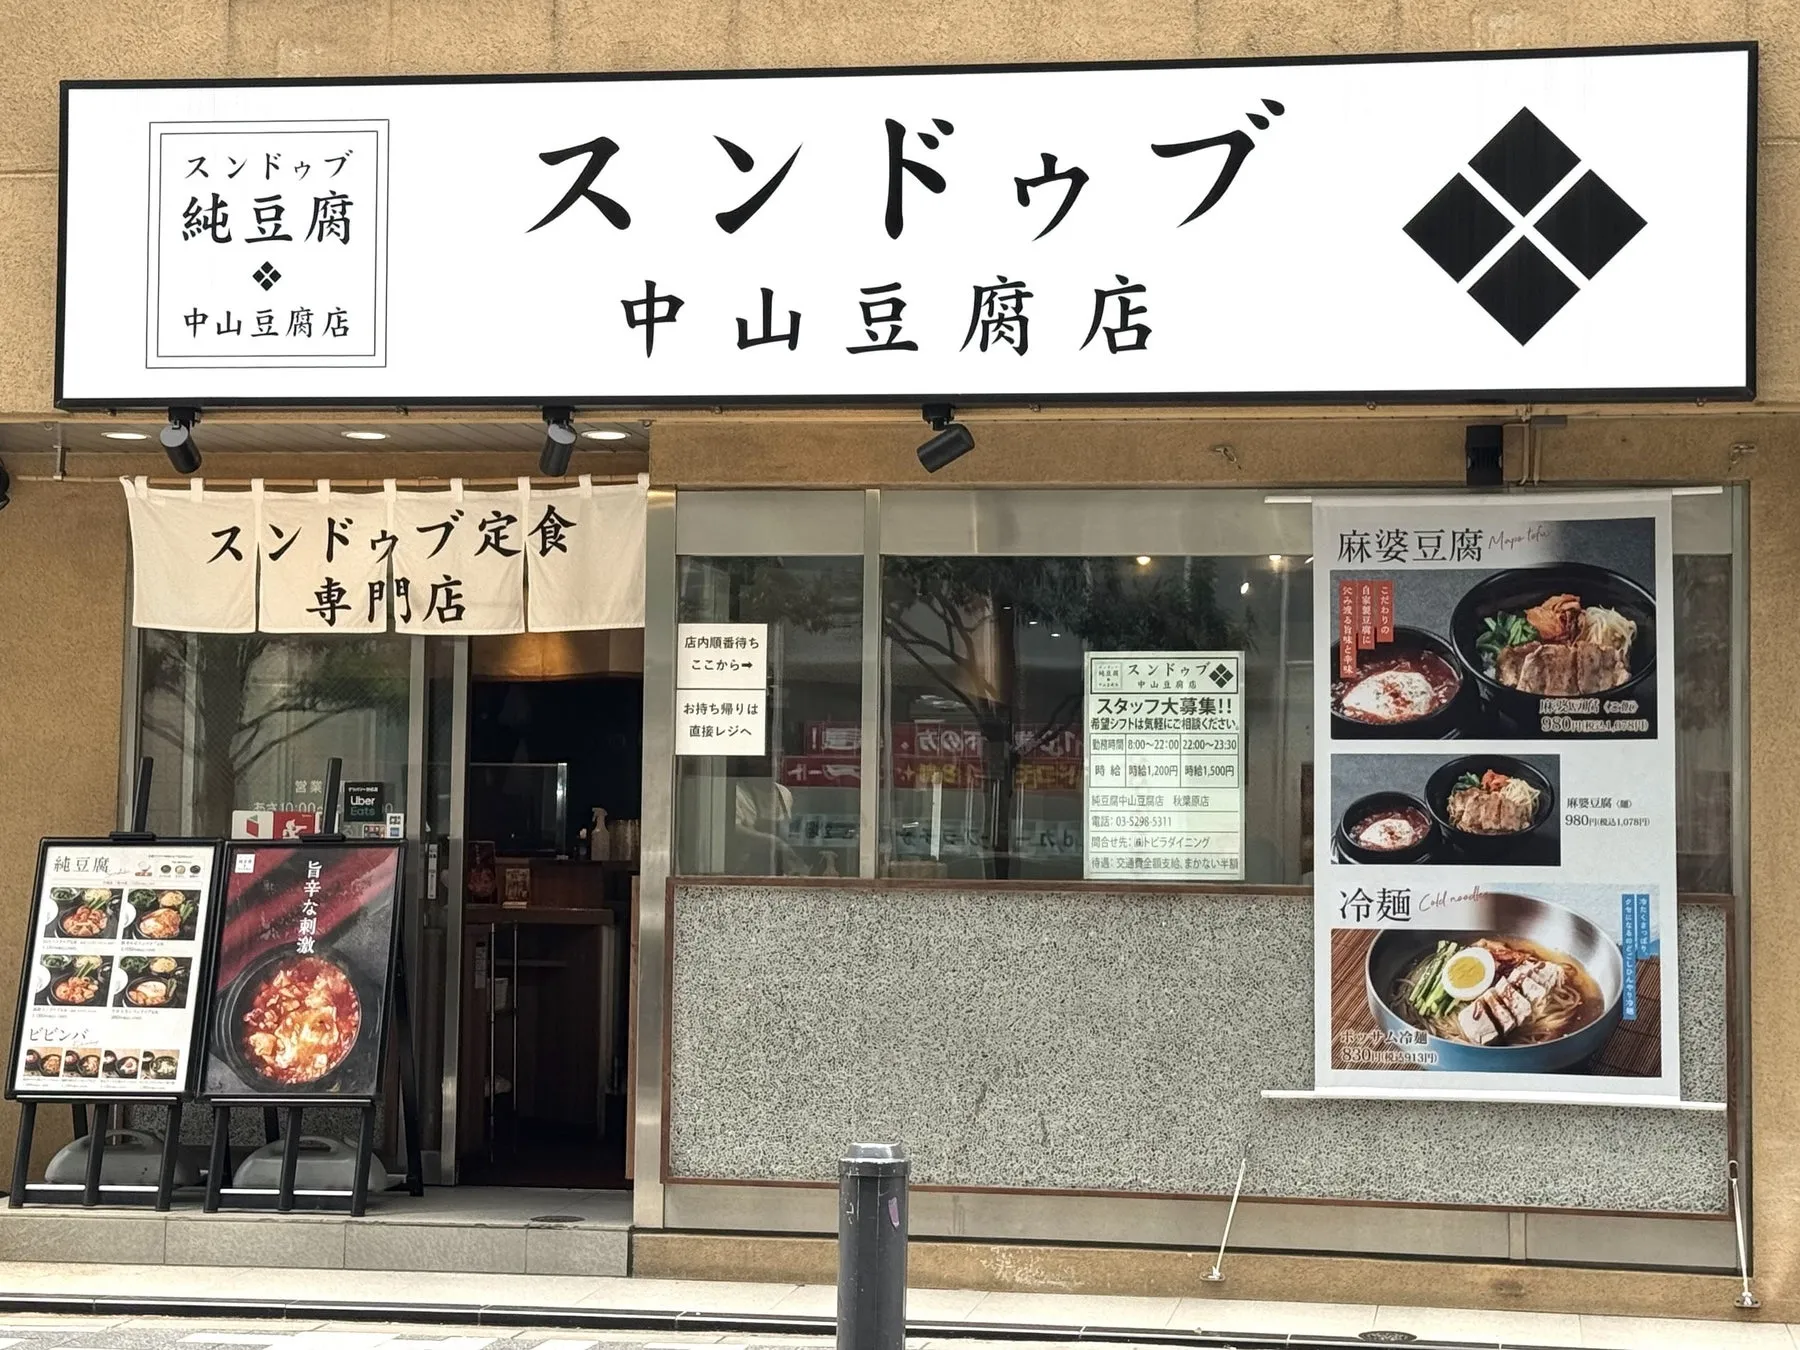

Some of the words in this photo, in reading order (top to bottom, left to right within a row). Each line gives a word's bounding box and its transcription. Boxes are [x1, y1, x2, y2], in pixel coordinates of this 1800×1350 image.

[185, 149, 354, 181] スンドゥブ
[526, 98, 1286, 241] スンドゥブ
[182, 189, 354, 246] 純豆腐
[183, 306, 350, 339] 中山豆腐店
[620, 273, 1153, 359] 中山豆腐店
[206, 503, 577, 564] スンドゥブ定食
[1337, 527, 1484, 564] 麻婆豆腐
[305, 574, 466, 627] 専門店
[1380, 586, 1390, 635] こだわりの
[684, 635, 760, 650] 店内順番待ち
[691, 659, 740, 672] ここから
[1128, 661, 1211, 677] スンドゥブ
[1137, 679, 1197, 690] 中山豆腐店
[682, 702, 759, 716] お持ち帰りは
[689, 724, 752, 738] 直接レジへ
[1092, 738, 1124, 751] 勤務時間
[1128, 764, 1179, 778] 時給1,200円
[1184, 764, 1235, 777] 時給1,500円
[350, 795, 376, 806] Uber
[350, 806, 376, 816] Eats
[54, 855, 110, 874] 純豆腐
[296, 860, 323, 954] 旨辛な刺激
[1339, 887, 1412, 923] 冷麺
[1418, 890, 1448, 912] Cold
[29, 1026, 89, 1042] ビビンバ
